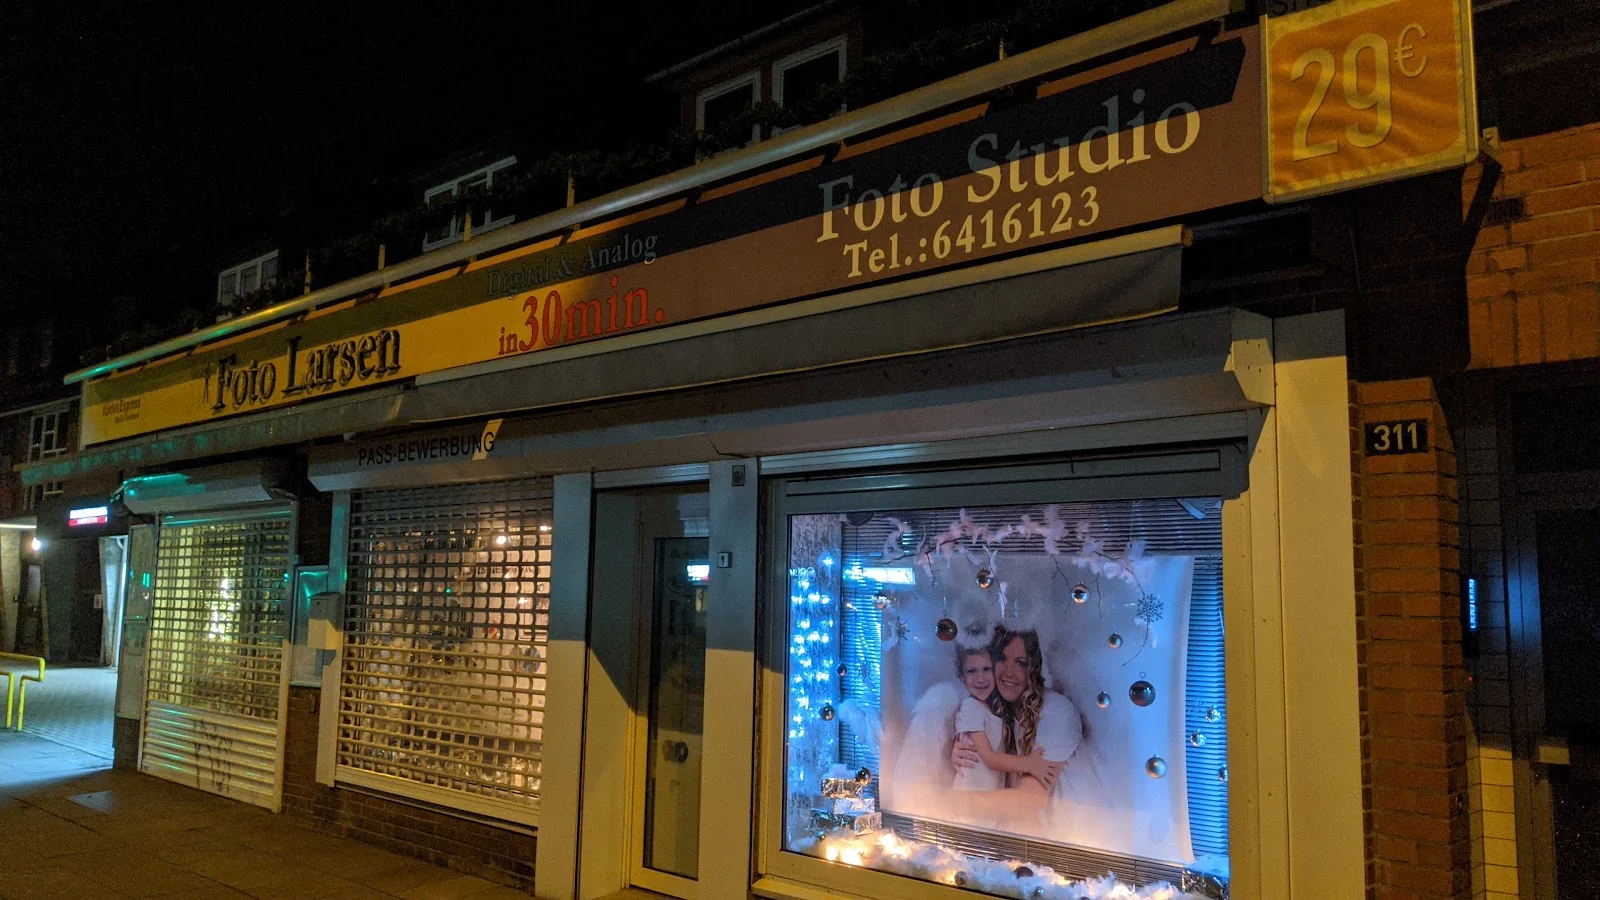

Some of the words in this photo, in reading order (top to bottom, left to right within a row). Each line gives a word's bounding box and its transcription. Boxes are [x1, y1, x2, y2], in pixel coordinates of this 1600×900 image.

[817, 172, 943, 243] Foto
[967, 89, 1200, 203] Studio
[487, 256, 551, 300] Digital
[557, 252, 575, 278] &
[582, 234, 658, 272] Analog
[210, 353, 276, 411] Foto
[281, 329, 401, 396] Larsen
[1373, 422, 1418, 451] 311
